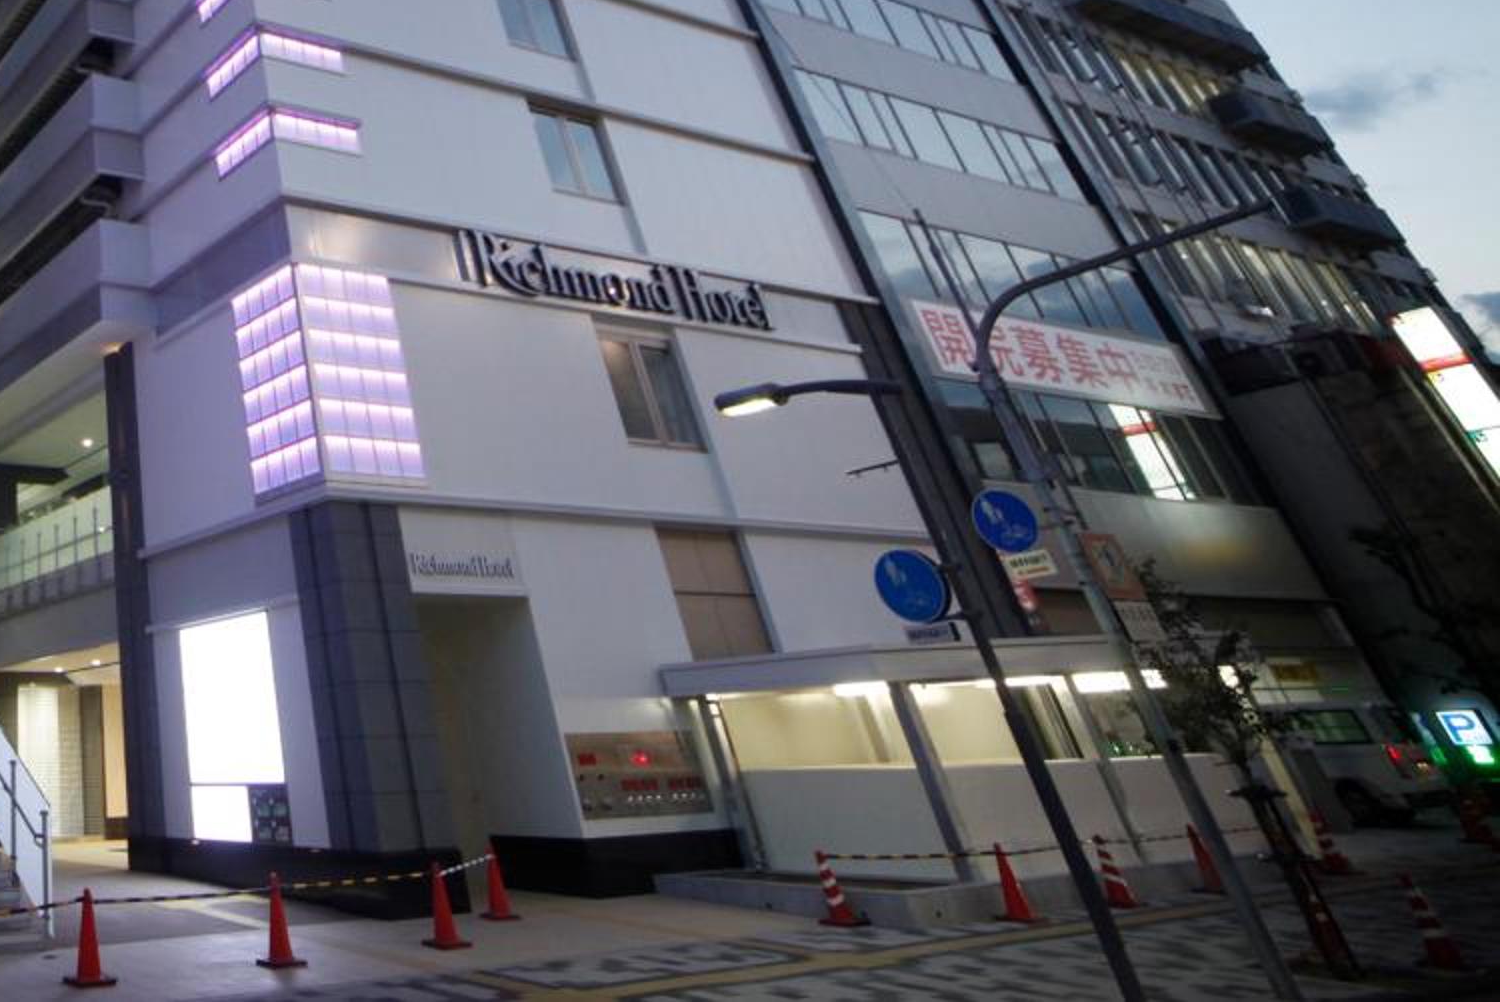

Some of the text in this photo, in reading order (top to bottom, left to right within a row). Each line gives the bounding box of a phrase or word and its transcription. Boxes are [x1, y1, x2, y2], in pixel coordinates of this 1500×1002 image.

[453, 228, 775, 331] Richmond Hotel
[1442, 713, 1476, 743] P
